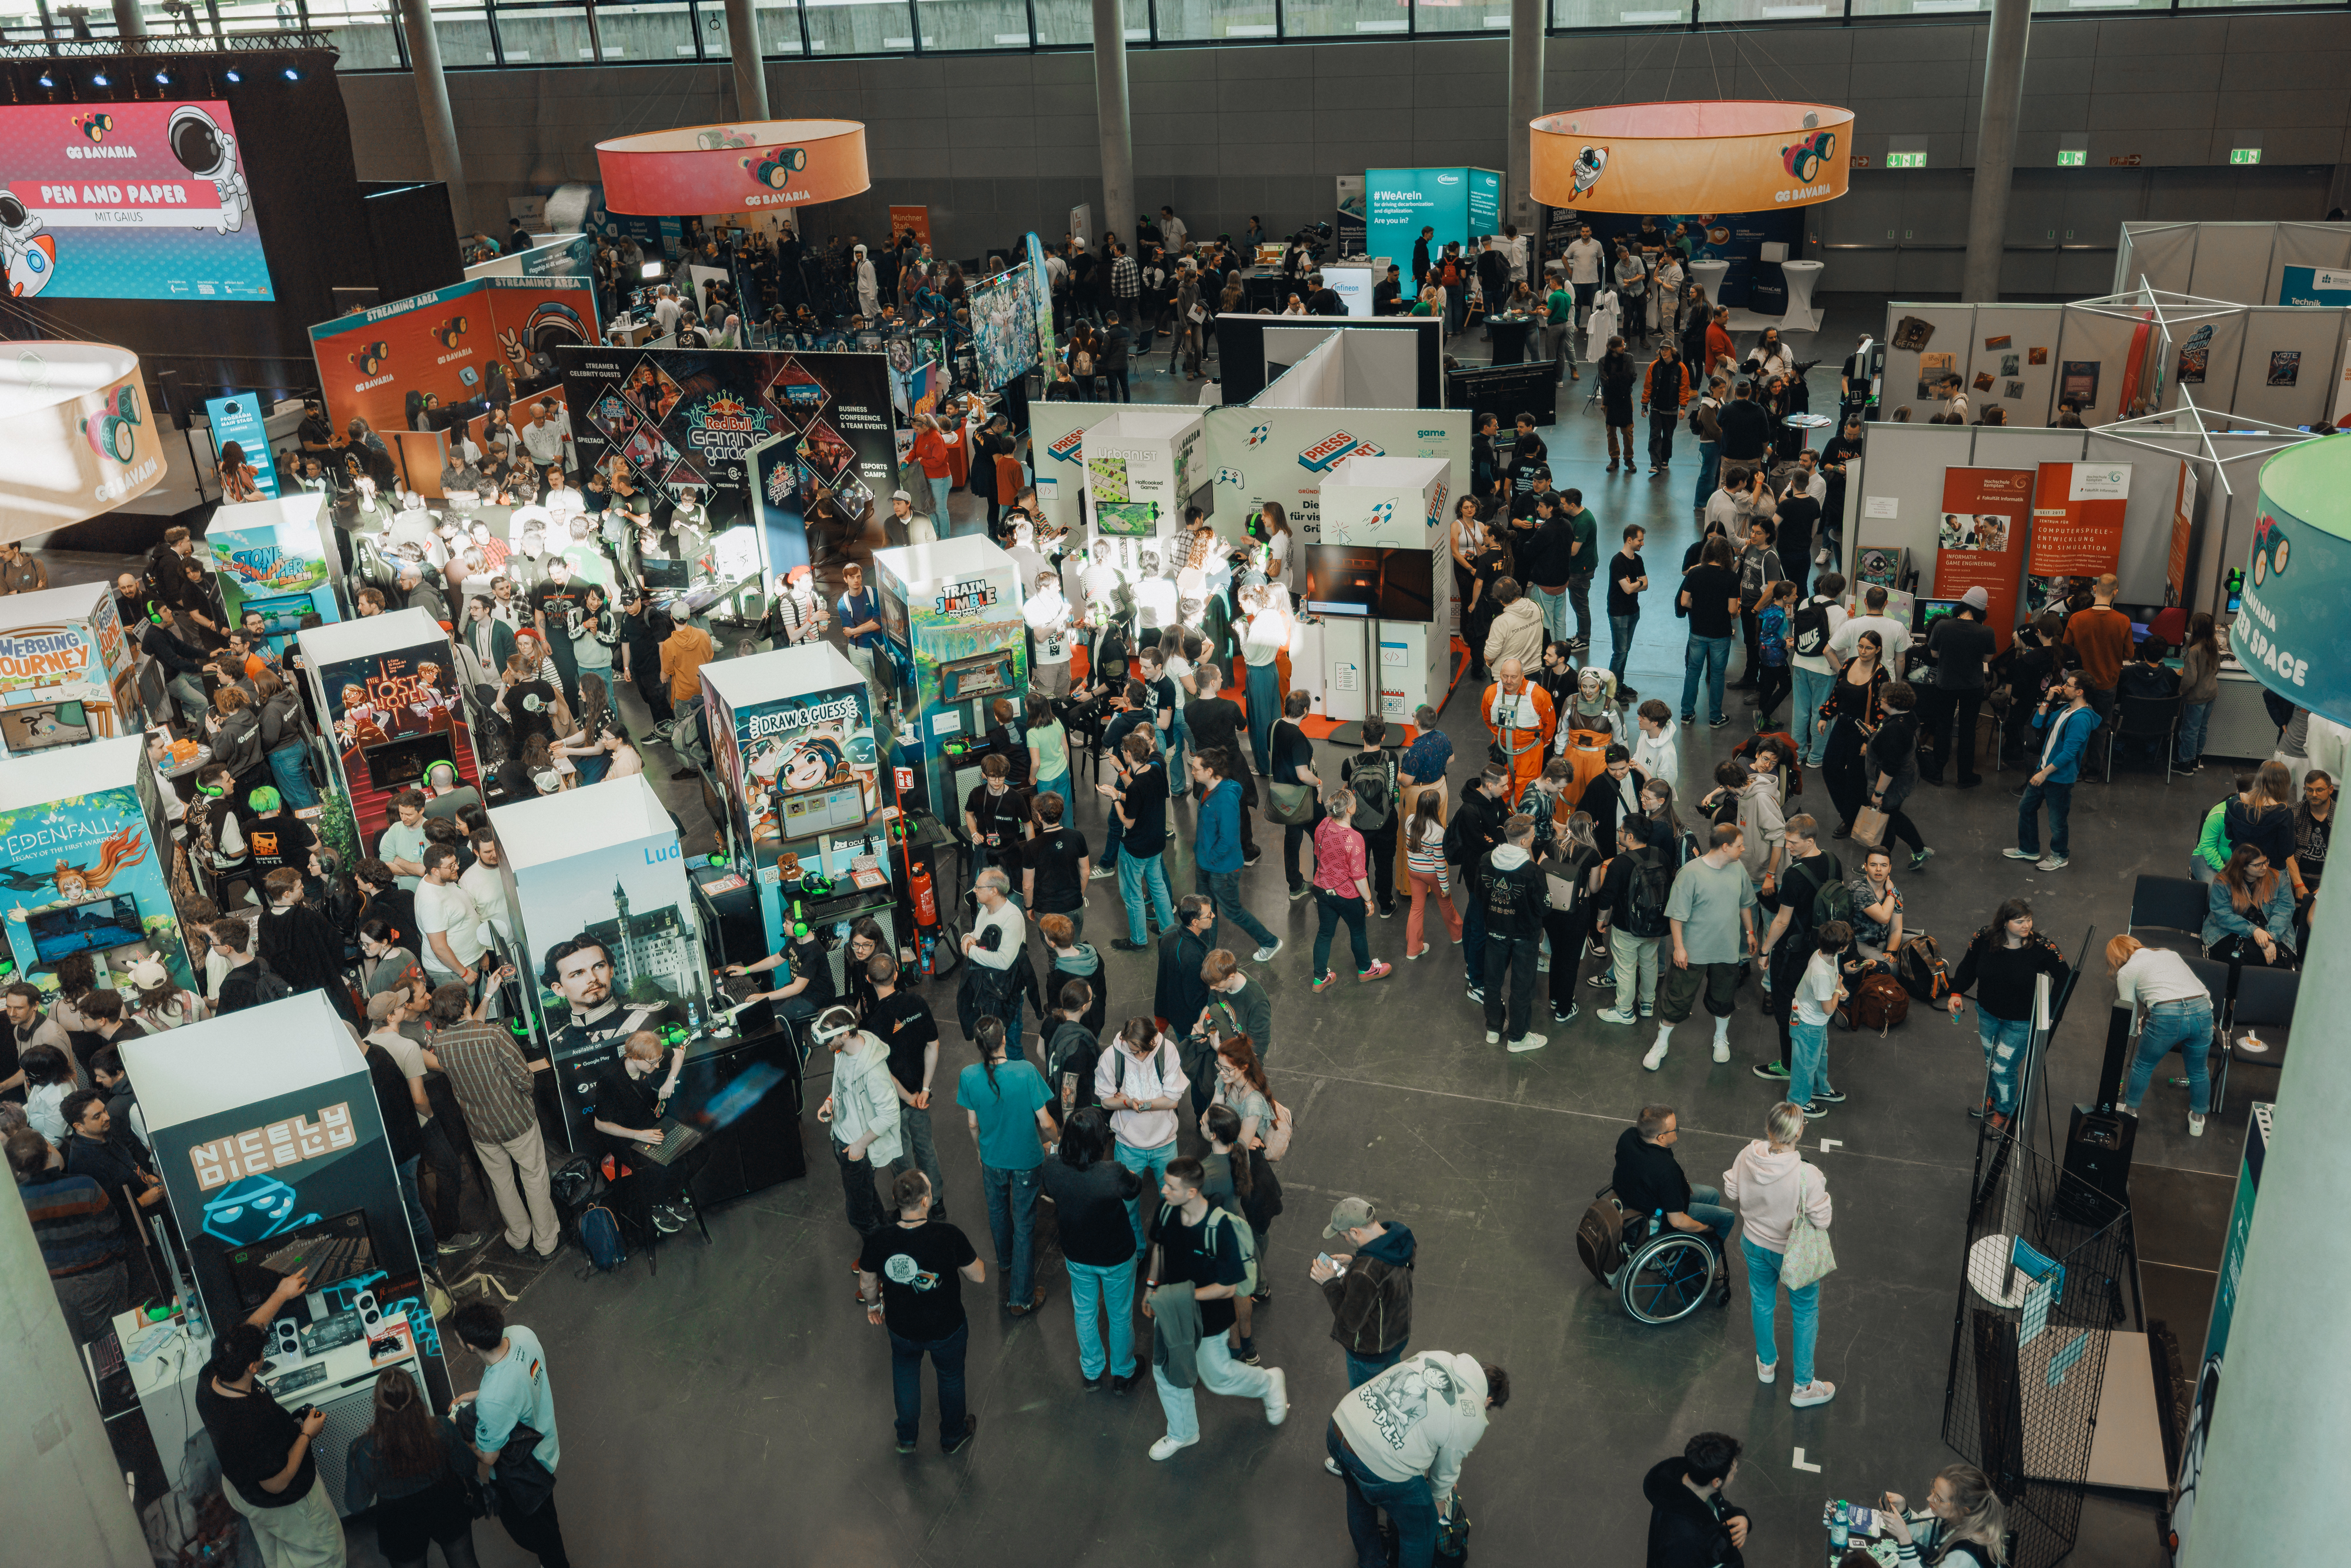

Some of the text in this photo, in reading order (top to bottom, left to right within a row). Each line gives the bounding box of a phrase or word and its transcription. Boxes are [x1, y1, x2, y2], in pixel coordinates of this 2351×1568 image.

[66, 146, 137, 159] GG BAVARIA
[41, 185, 187, 203] PEN AND PAPER
[745, 190, 811, 206] GG BAVARIA
[1374, 191, 1422, 200] #WeAreIn
[1775, 183, 1830, 202] GG BAVARIA
[95, 212, 143, 222] MIT GAIUS
[1553, 213, 1576, 222] GEWINNEN
[529, 264, 545, 274] Flagship
[495, 278, 581, 289] STREAMING AREA
[1335, 283, 1359, 292] infineon
[367, 293, 438, 321] STREAMING AREA
[2292, 297, 2321, 307] Technik
[1895, 339, 1924, 349] GEFAHR
[437, 347, 473, 364] GG BAVARIA
[355, 373, 394, 393] GG BAVARIA
[220, 413, 252, 422] PROGRAMM
[705, 416, 753, 431] Red Bull
[692, 430, 767, 446] GAMING
[1053, 430, 1083, 453] PRESS
[1418, 430, 1445, 438] game
[1304, 433, 1352, 461] PRESS
[95, 457, 158, 502] GG BAVARIA
[769, 479, 795, 497] GAMING
[773, 487, 793, 505] garden
[1302, 501, 1319, 509] Die
[1429, 481, 1441, 517] PRESS
[1435, 484, 1448, 519] START
[1290, 512, 1305, 521] für
[232, 545, 282, 567] STONE
[279, 571, 312, 586] DASH
[942, 580, 986, 599] TRAIN
[936, 588, 996, 615] JUMBLE
[2245, 585, 2276, 632] BAVARIA
[100, 611, 122, 658] JOURNEY
[1799, 628, 1818, 648] NIKE
[0, 632, 80, 658] WEBBING
[0, 645, 88, 677] OURNEY
[2250, 628, 2309, 687] SPACE
[368, 675, 418, 703] LOST
[373, 689, 428, 711] HOTEL
[762, 703, 848, 732] DRAW & GUESS
[7, 817, 118, 856] EDENFALL
[12, 851, 38, 863] LEGACY
[49, 846, 63, 855] THE
[65, 842, 84, 852] FIRST
[85, 834, 120, 847] WARDENS
[644, 839, 680, 865] Lud
[572, 1046, 594, 1055] Available
[195, 1107, 347, 1167] NICELY
[201, 1124, 353, 1187] DICELY
[266, 1250, 283, 1258] CLEAN
[297, 1241, 312, 1249] YOUR
[315, 1234, 332, 1244] ROOM!
[381, 1332, 397, 1340] AWARD
[534, 1367, 543, 1385] GER
